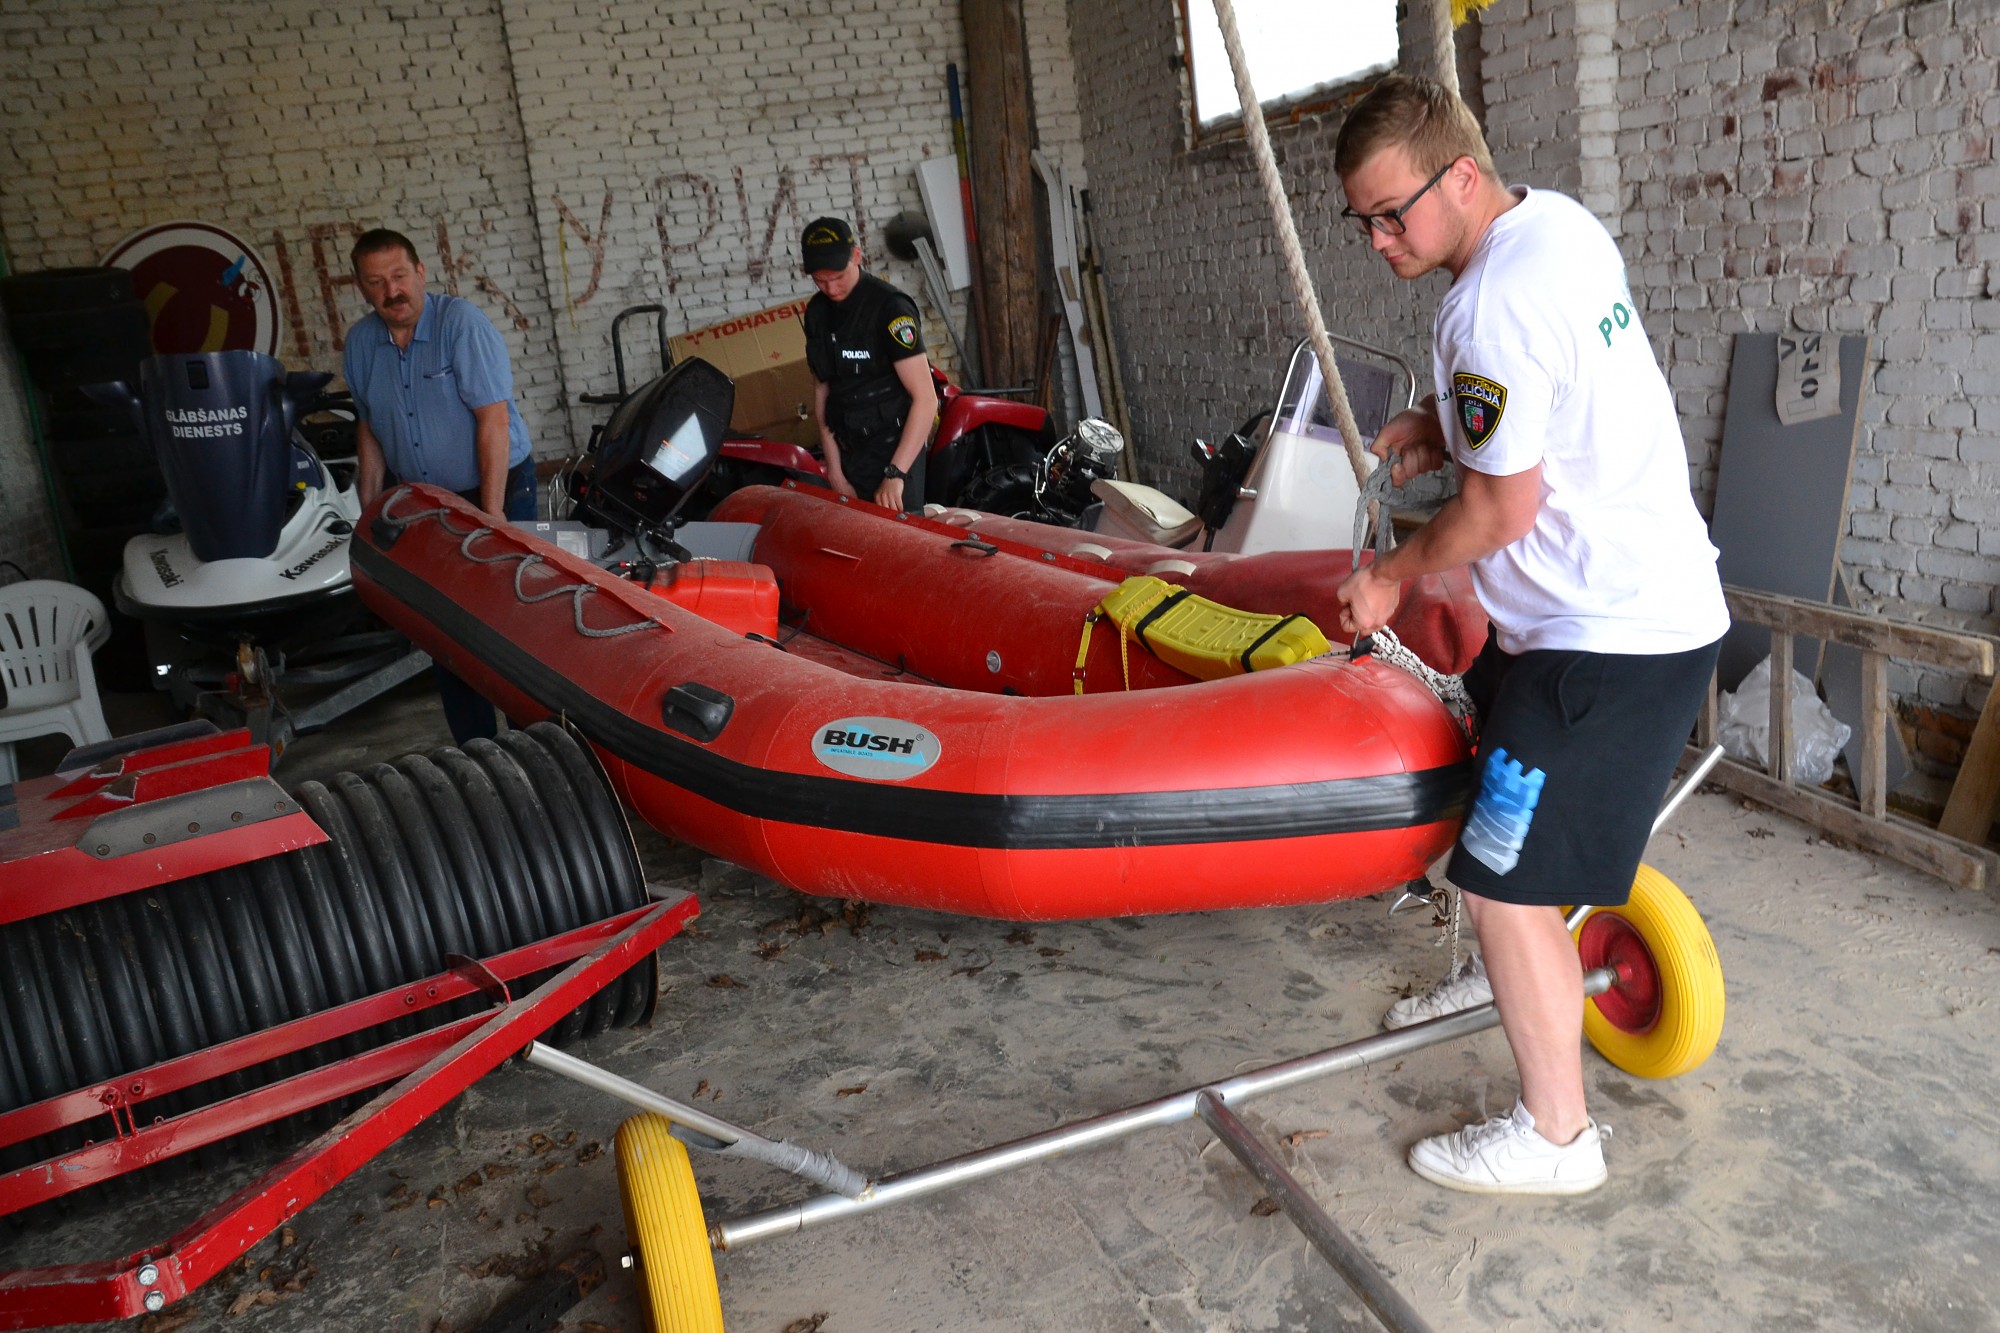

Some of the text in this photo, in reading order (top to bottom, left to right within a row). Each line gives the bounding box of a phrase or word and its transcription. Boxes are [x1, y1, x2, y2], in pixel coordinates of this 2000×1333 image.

[709, 301, 807, 340] TOHATSU
[842, 350, 871, 359] POLICIJA
[1457, 383, 1500, 406] POLICIJA
[165, 406, 248, 423] GLĀBŠANAS
[172, 422, 243, 438] DIENESTS
[150, 548, 185, 589] Kawasaki
[279, 537, 345, 581] Kawasaki
[823, 729, 915, 754] BUSH
